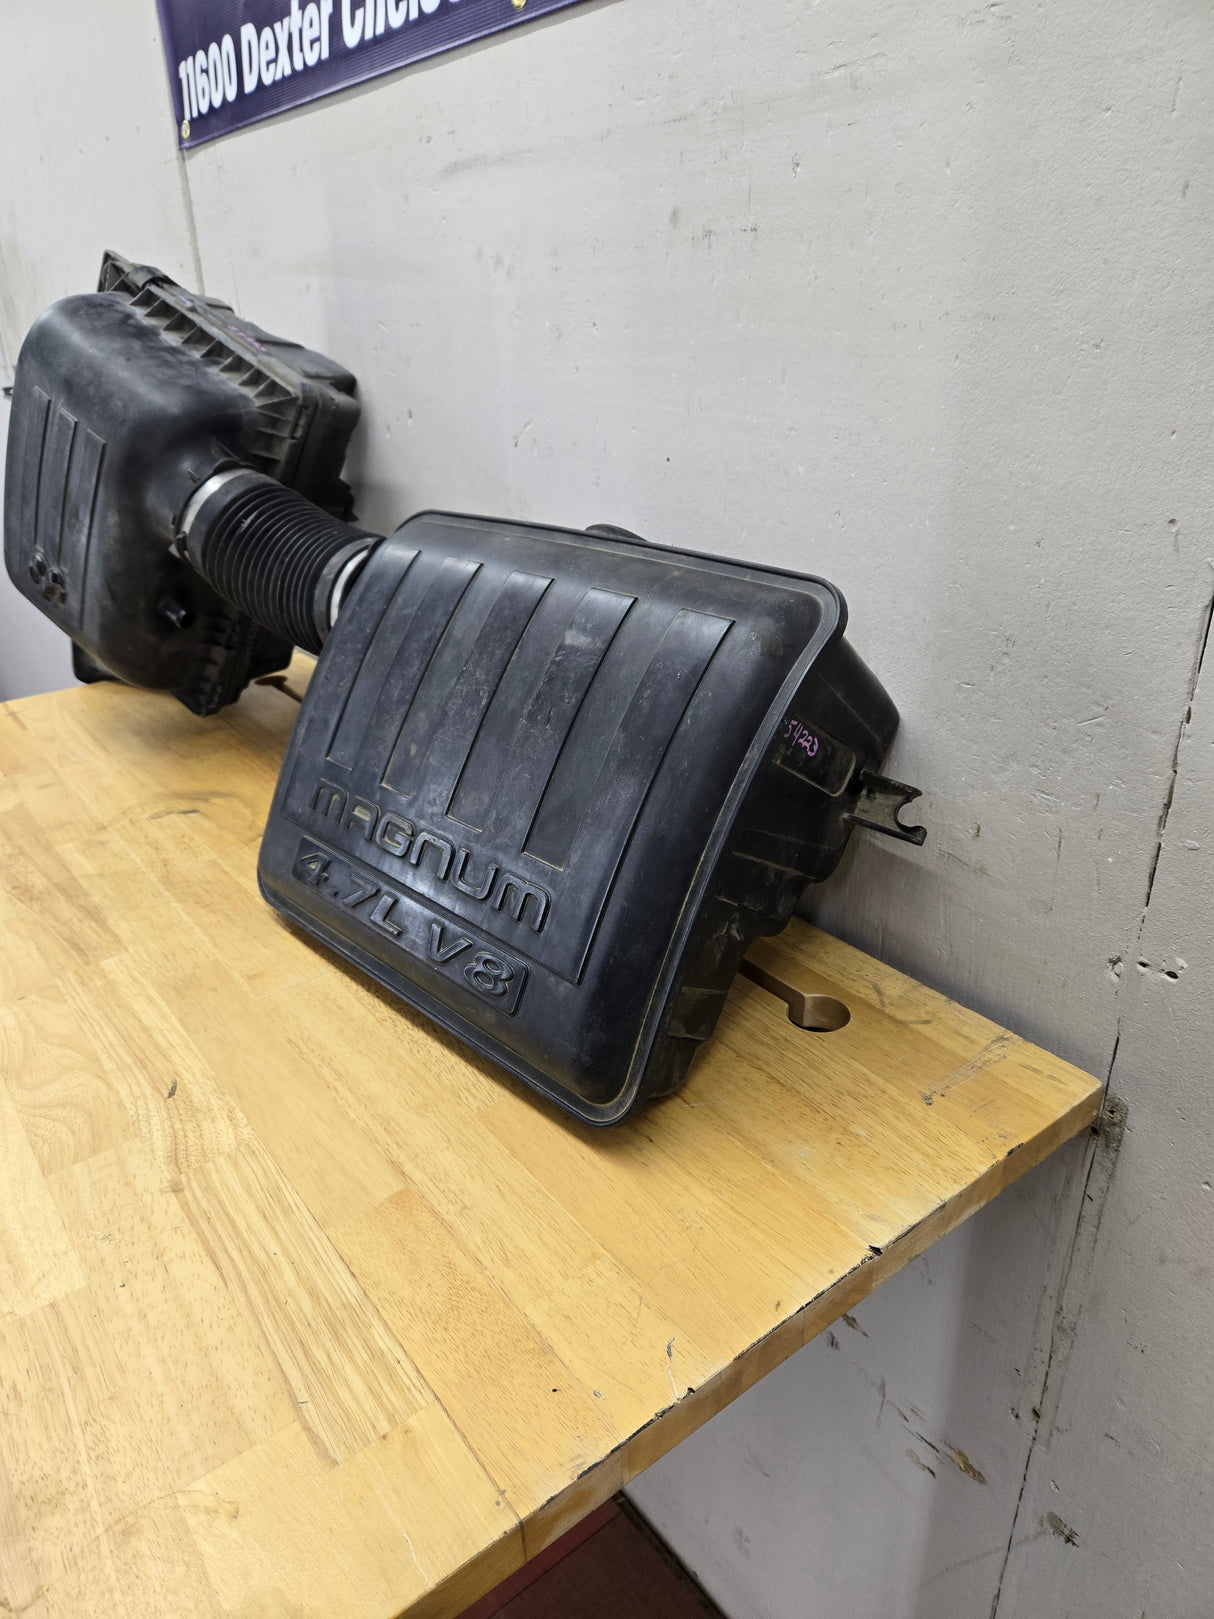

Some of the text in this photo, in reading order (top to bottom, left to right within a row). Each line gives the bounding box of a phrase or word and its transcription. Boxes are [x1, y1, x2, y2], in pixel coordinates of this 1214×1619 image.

[178, 34, 237, 121] 11600
[240, 0, 333, 94] Dexter
[297, 851, 514, 997] 4.7L V8
